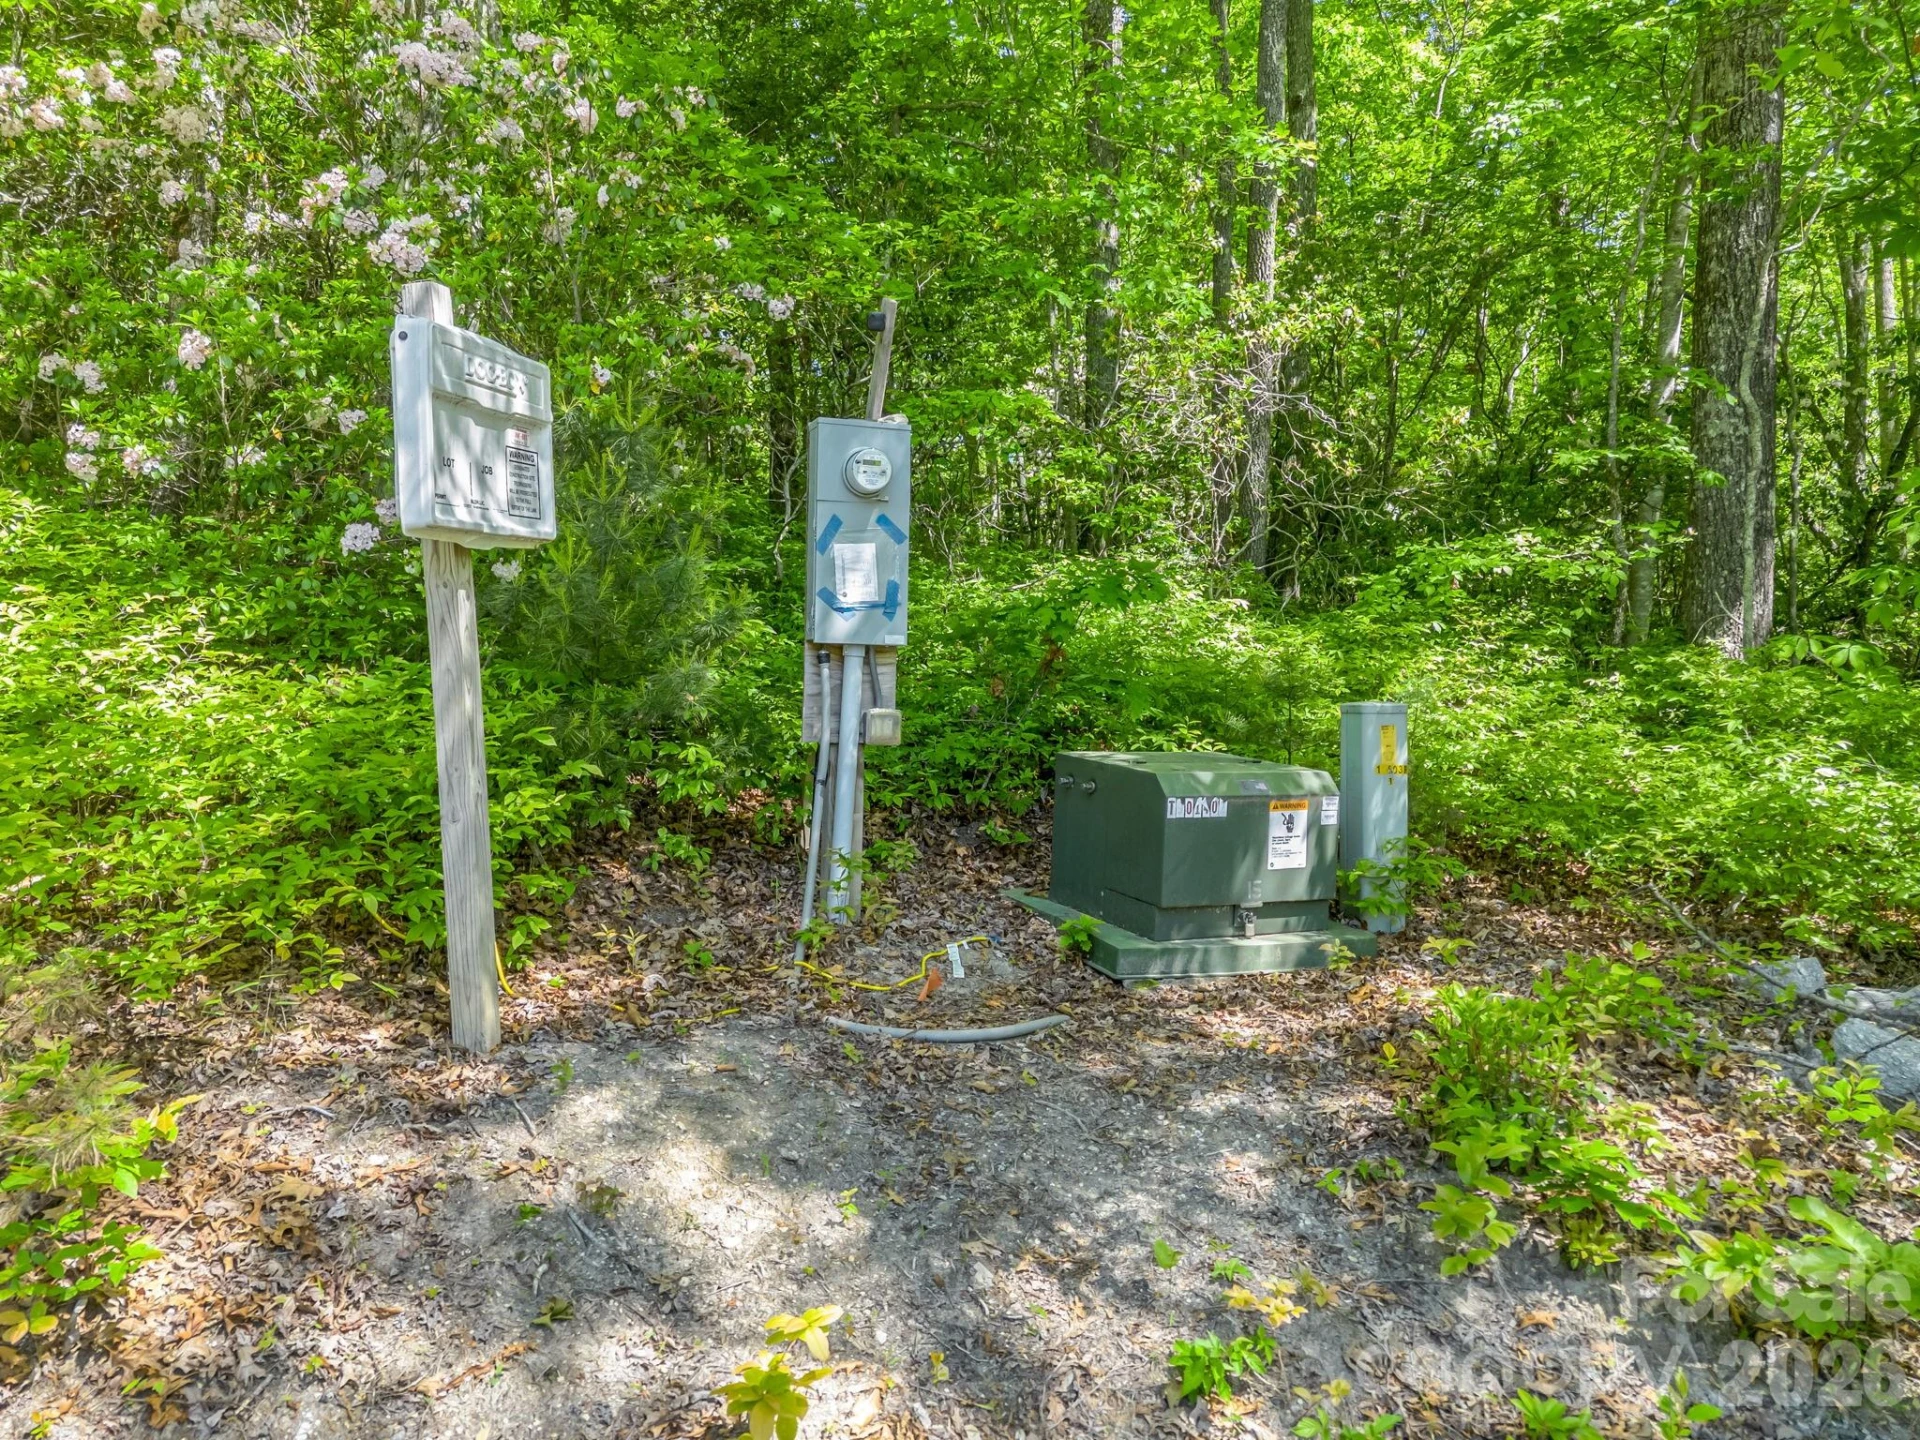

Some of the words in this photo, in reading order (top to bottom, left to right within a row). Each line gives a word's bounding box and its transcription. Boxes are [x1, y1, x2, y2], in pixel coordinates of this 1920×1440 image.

[509, 449, 535, 463] WARNING
[442, 456, 455, 468] LOT
[480, 465, 493, 475] JOB
[1279, 802, 1306, 810] WARNING
